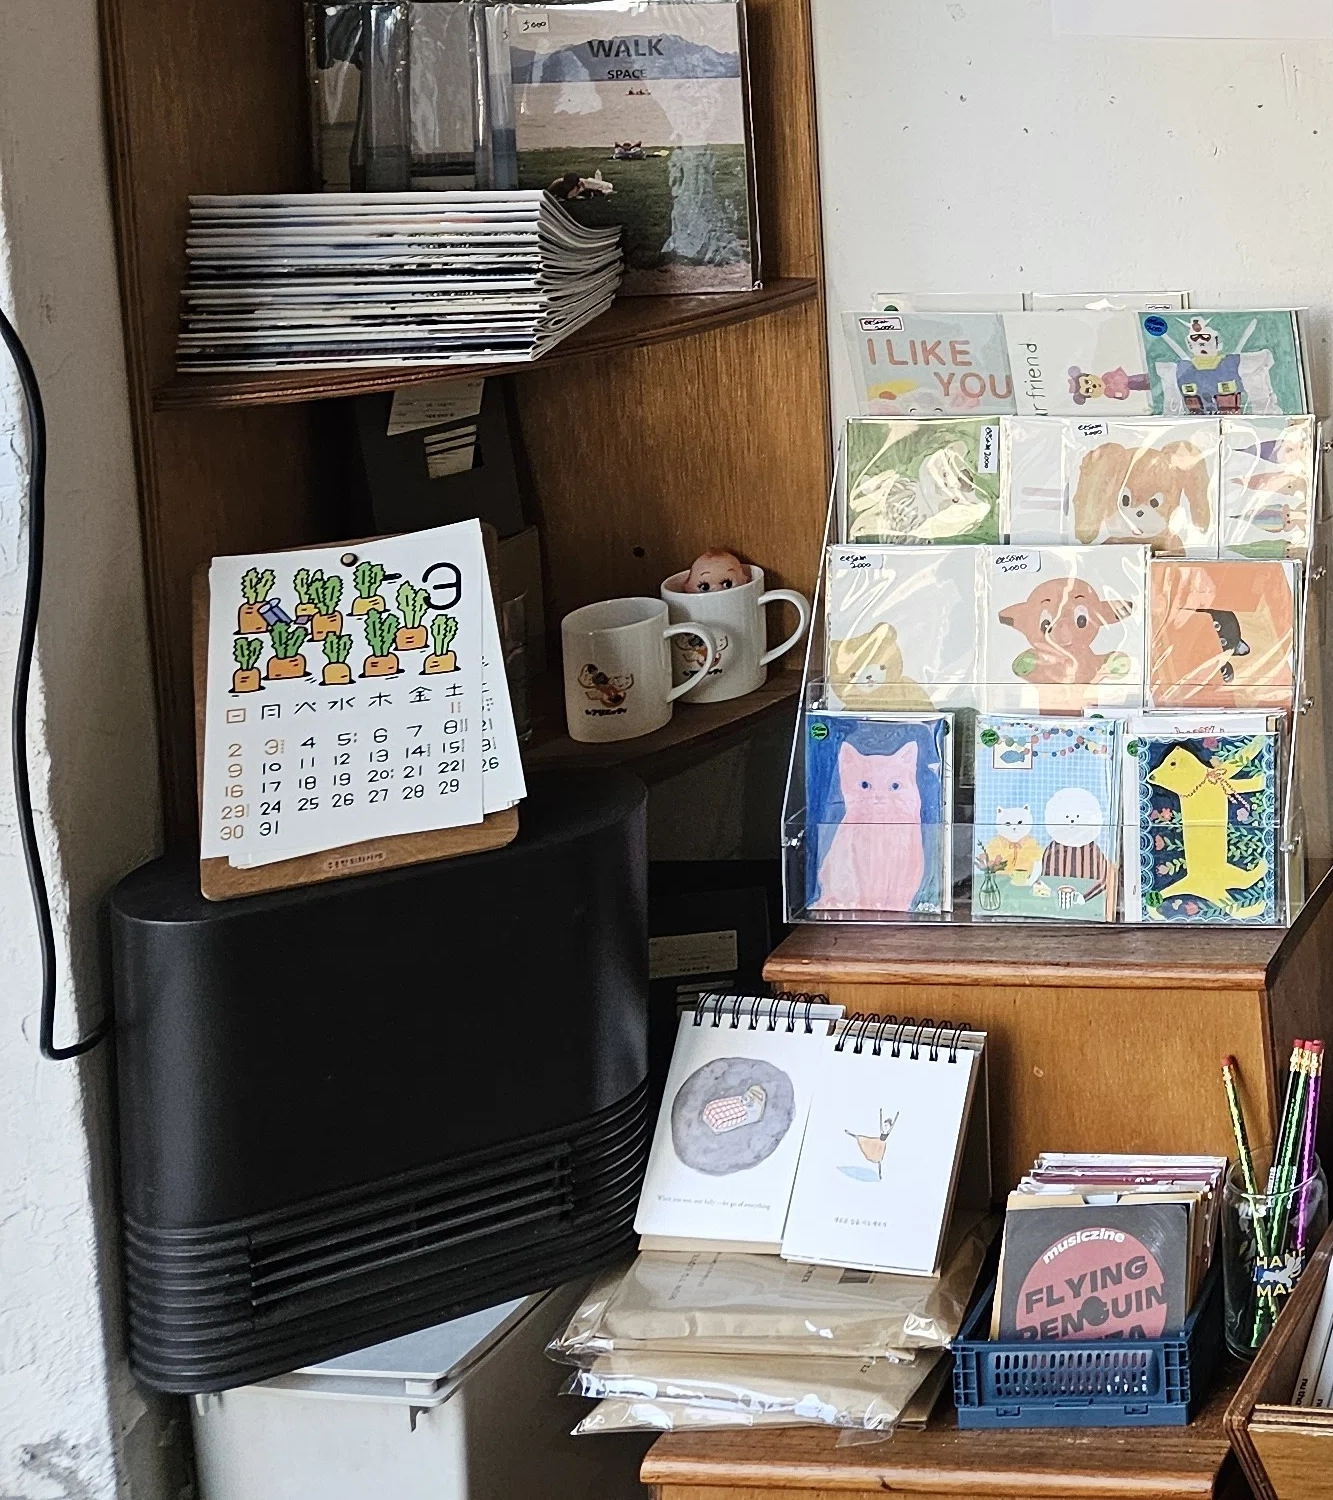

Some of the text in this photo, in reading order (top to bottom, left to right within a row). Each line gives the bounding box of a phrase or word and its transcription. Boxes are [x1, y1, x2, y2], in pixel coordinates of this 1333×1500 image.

[587, 38, 664, 60] WALK
[607, 66, 648, 80] SPACE
[868, 339, 973, 366] I LIKE
[934, 371, 1013, 400] YOU
[1024, 343, 1049, 402] friend
[1002, 563, 1027, 572] 2000
[422, 563, 462, 610] 3
[226, 684, 463, 723] 日 月 水 木 金 土
[260, 780, 460, 815] 24 25 26 27 28 29
[260, 821, 279, 836] 31
[1043, 1228, 1125, 1264] musiczine
[1025, 1256, 1148, 1315] FLYING
